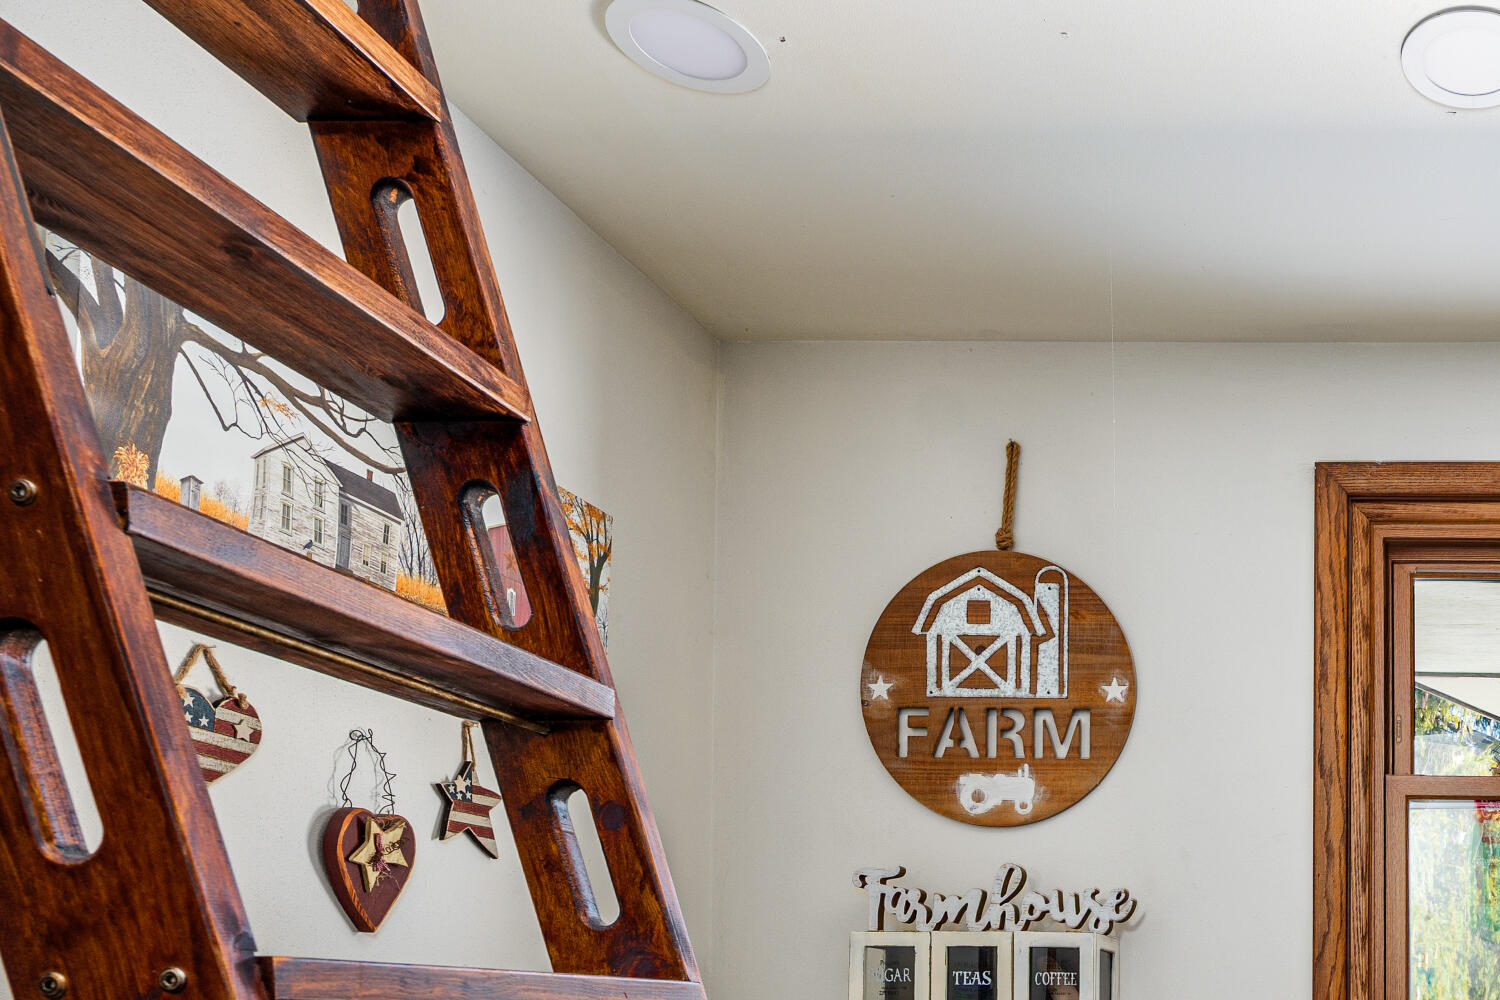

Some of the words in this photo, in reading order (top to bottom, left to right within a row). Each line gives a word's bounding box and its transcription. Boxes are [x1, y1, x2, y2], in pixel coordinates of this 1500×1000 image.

[896, 707, 1092, 760] FARM
[852, 863, 1138, 935] Farmhouse
[870, 968, 912, 983] GAR
[952, 970, 993, 986] TEAS
[1034, 971, 1078, 986] COFFEE
